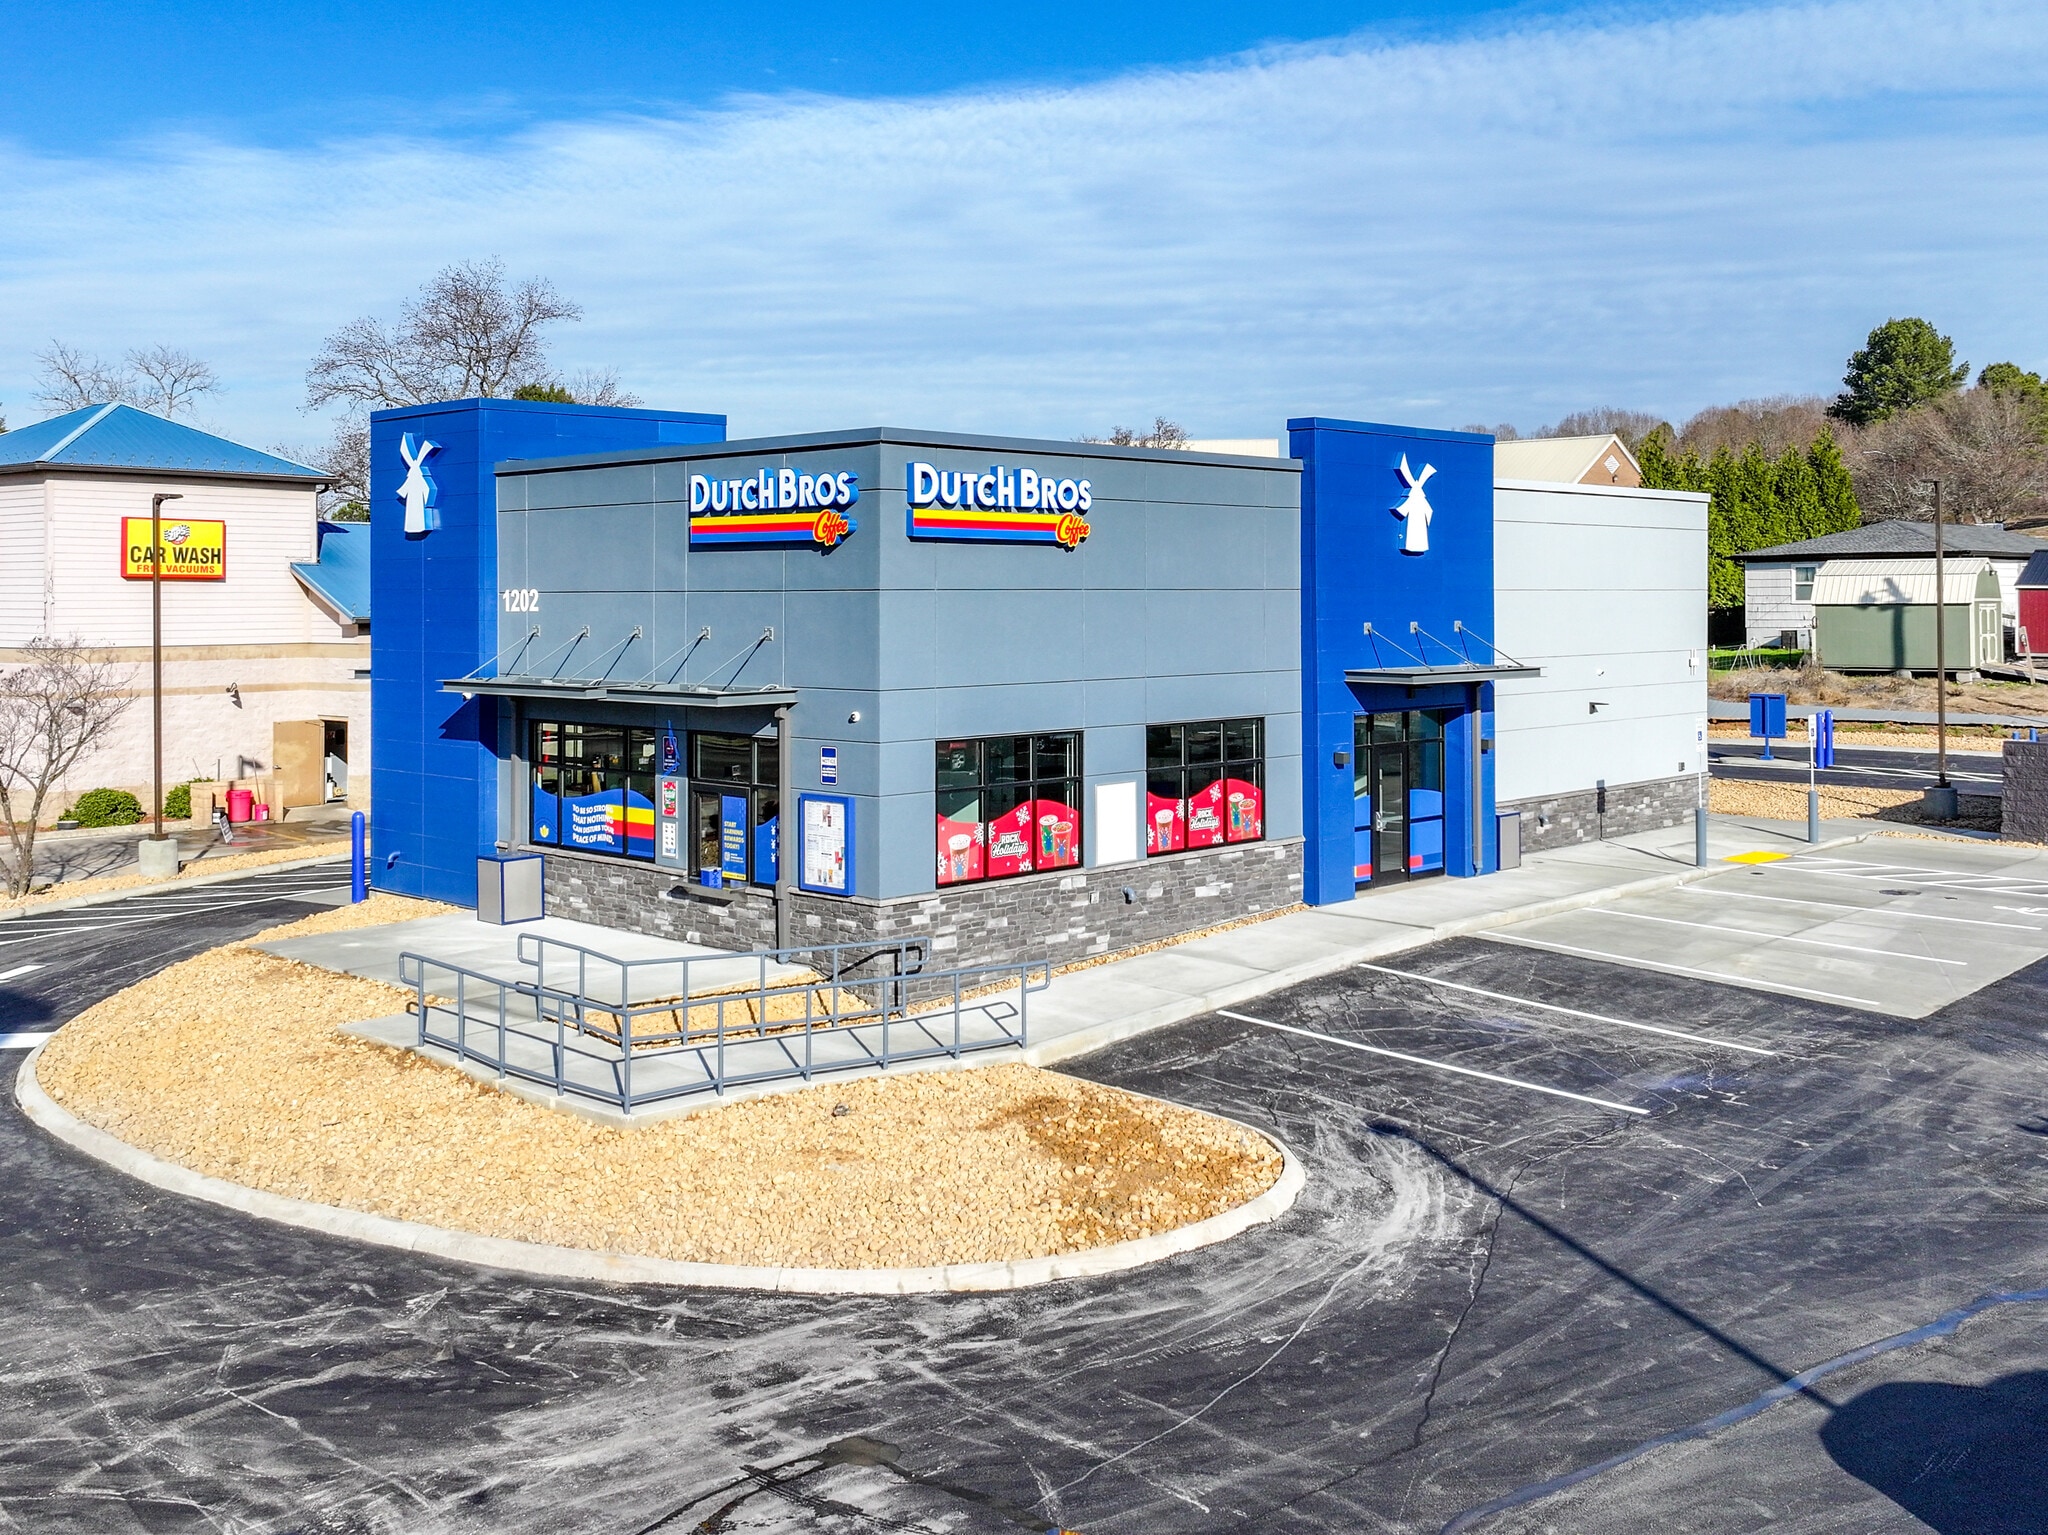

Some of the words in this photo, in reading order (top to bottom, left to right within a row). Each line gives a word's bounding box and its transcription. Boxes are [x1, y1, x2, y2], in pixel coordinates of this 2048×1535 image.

[813, 509, 849, 546] Coffee
[1056, 512, 1091, 547] Coffee
[130, 546, 166, 564] CAR
[172, 547, 221, 565] WASH
[166, 565, 215, 574] VACUUMS
[502, 588, 540, 612] 1202
[572, 804, 579, 813] TO
[586, 806, 593, 814] SO
[572, 813, 587, 825] THAT
[587, 813, 614, 825] NOTHING
[572, 824, 583, 834] CAN
[572, 832, 589, 844] PEACE
[589, 834, 597, 843] OF
[1001, 833, 1019, 844] ROCK
[991, 841, 1028, 859] Holidays
